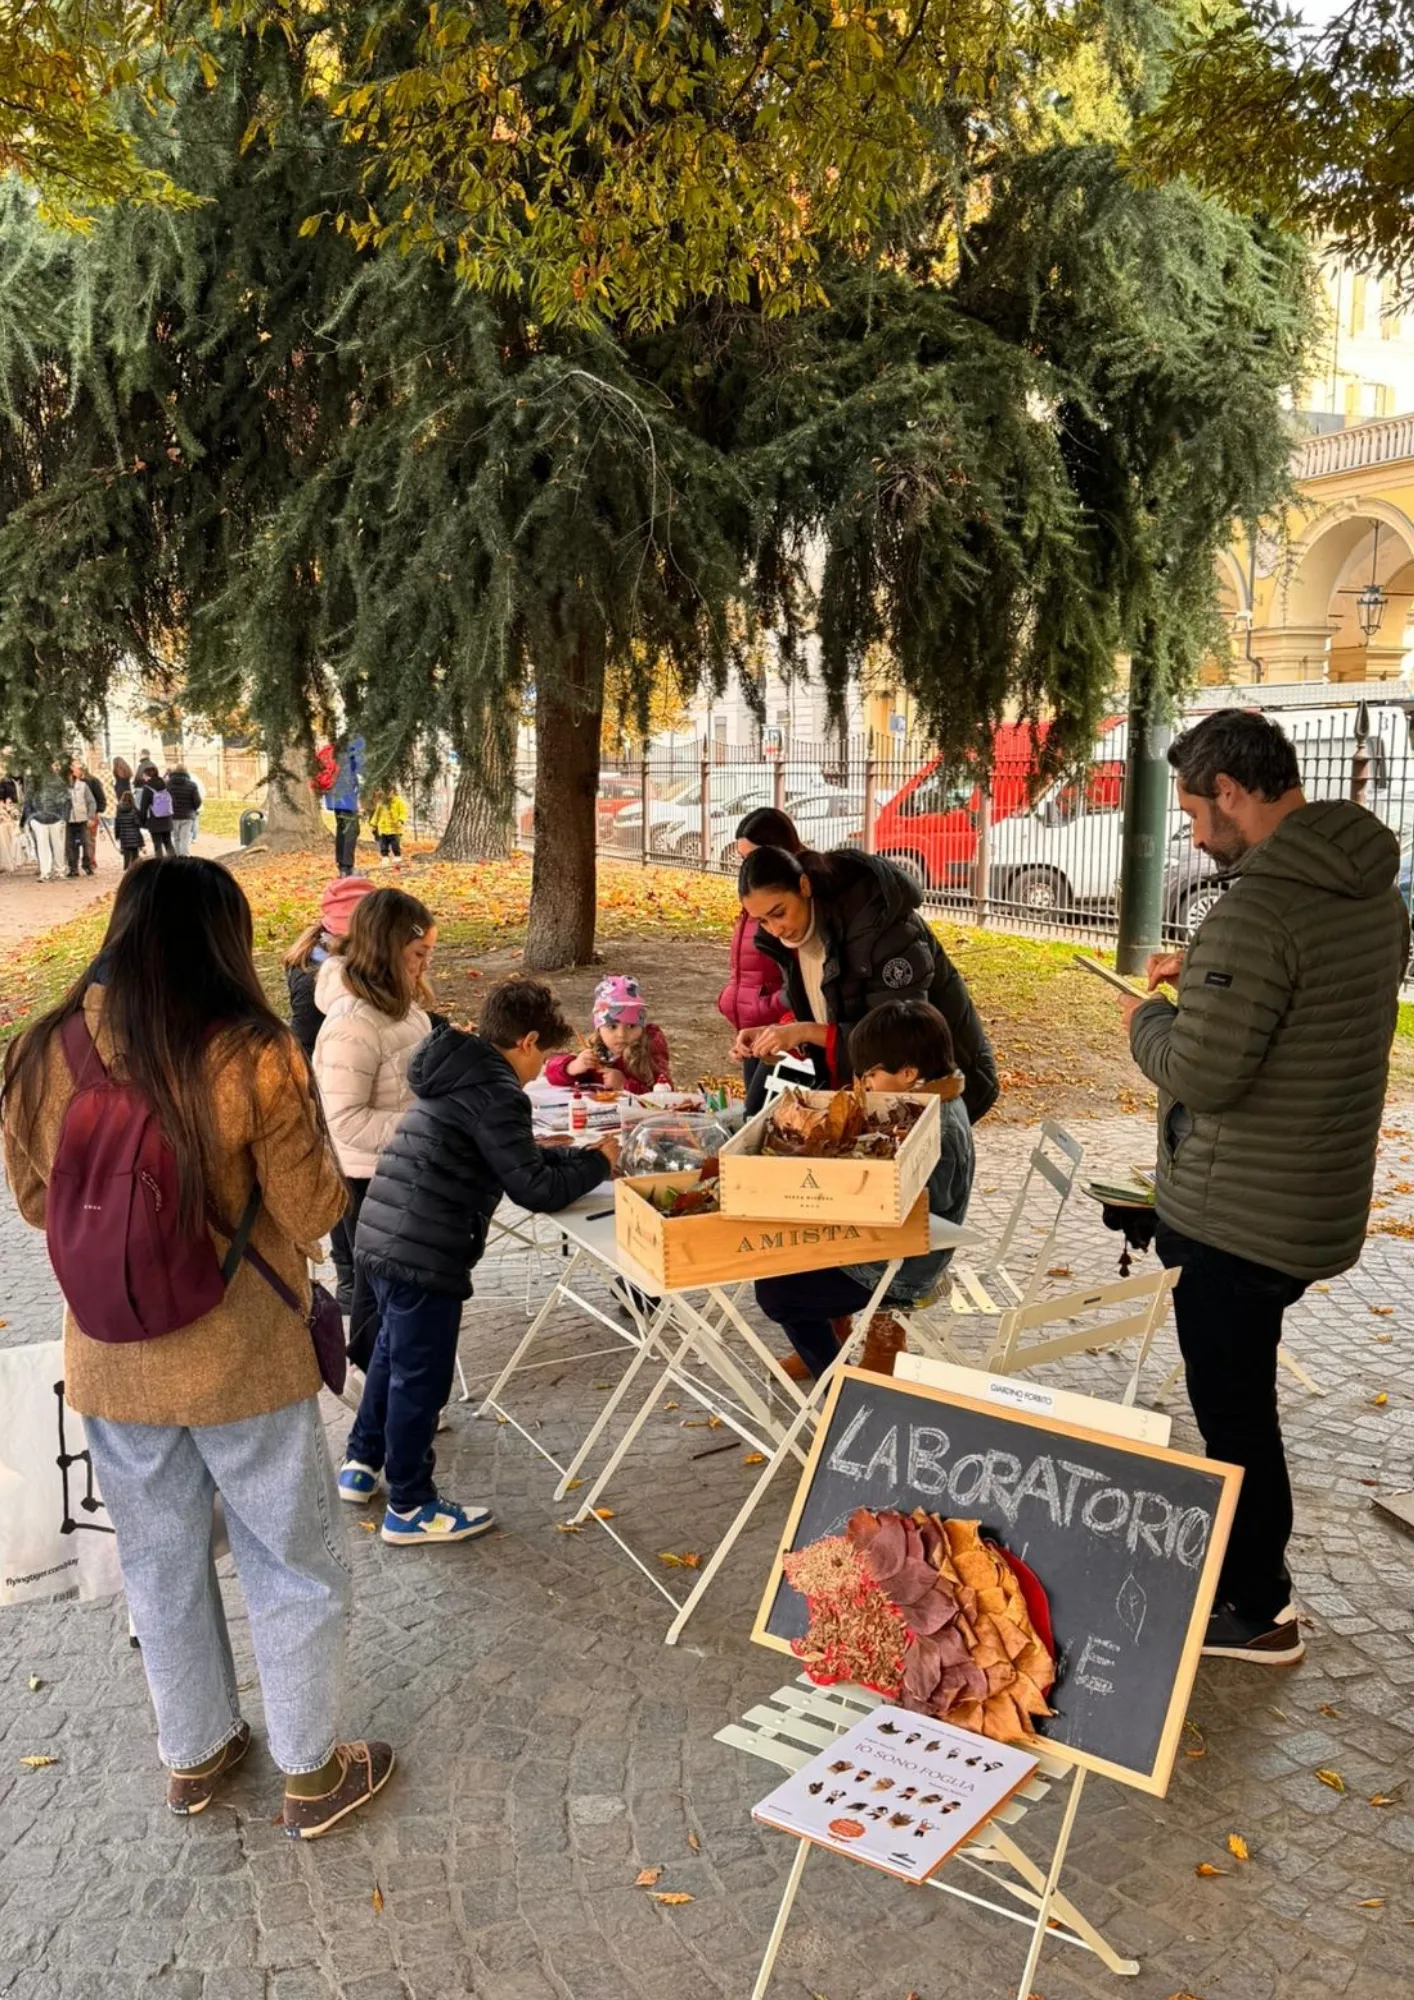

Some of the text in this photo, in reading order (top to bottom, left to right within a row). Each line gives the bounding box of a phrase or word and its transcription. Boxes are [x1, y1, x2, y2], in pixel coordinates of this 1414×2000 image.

[736, 1224, 861, 1253] AMISTA
[826, 1404, 1212, 1570] LABORATORIO
[855, 1743, 873, 1754] IO
[874, 1750, 918, 1771] SONO
[920, 1766, 976, 1792] FOGLIA
